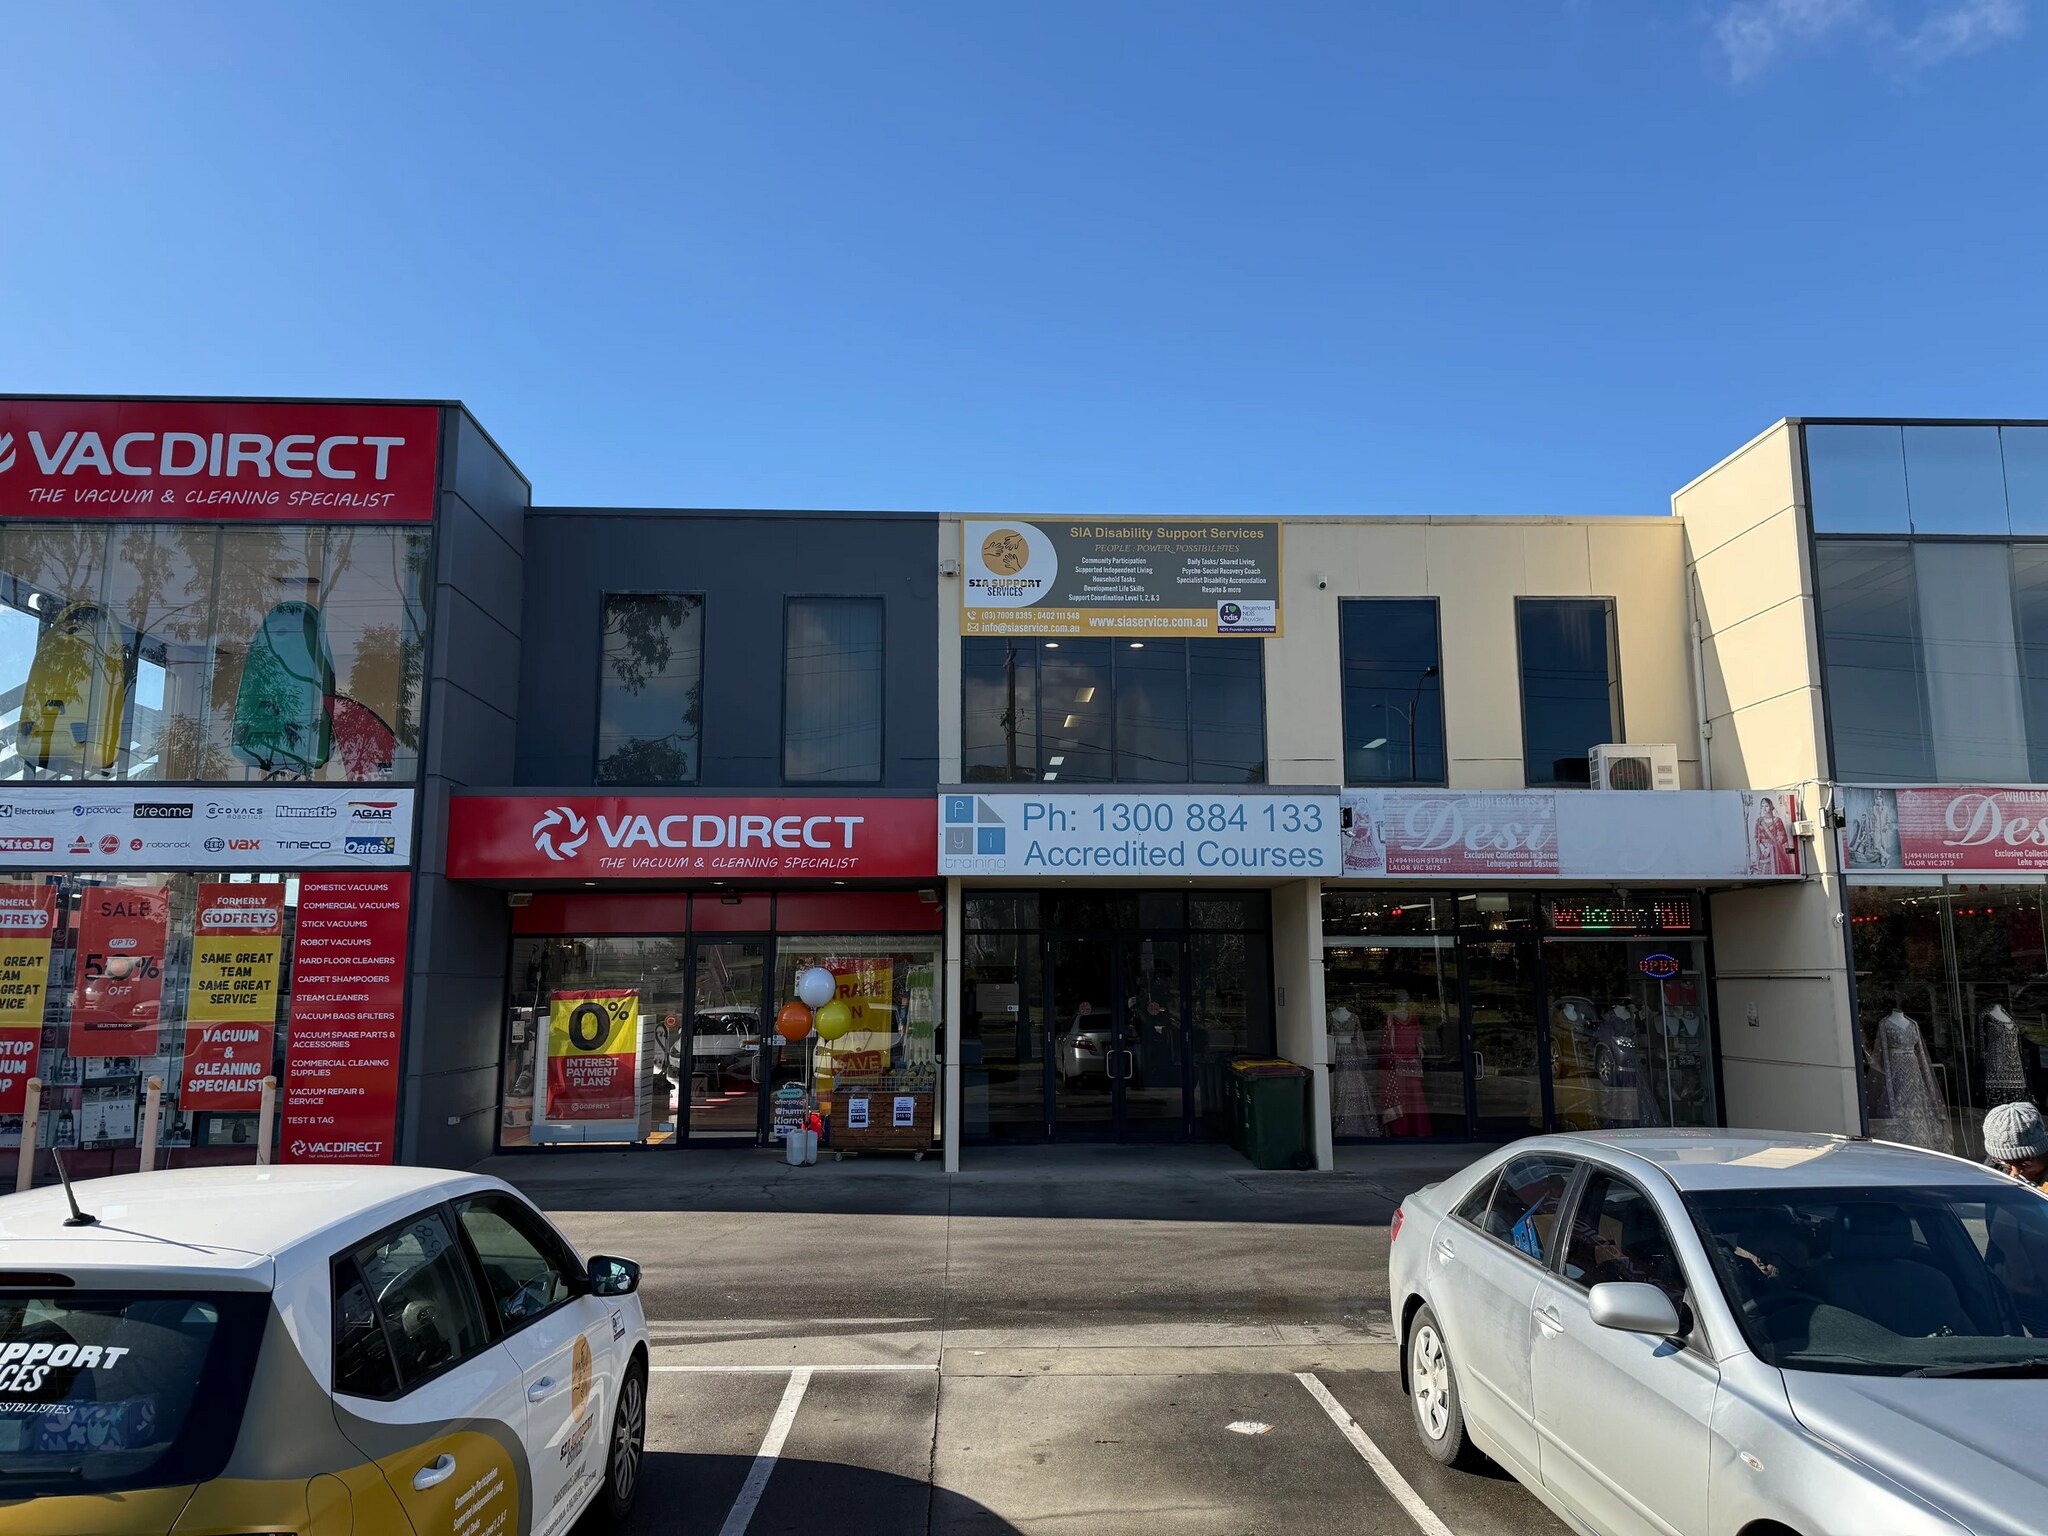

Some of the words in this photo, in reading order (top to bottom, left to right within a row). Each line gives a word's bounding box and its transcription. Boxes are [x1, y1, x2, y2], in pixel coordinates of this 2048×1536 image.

[28, 431, 405, 480] VACDIRECT
[29, 488, 67, 503] THE
[74, 489, 153, 503] VACUUM
[161, 490, 175, 503] &
[185, 490, 280, 506] CLEANING
[287, 491, 395, 508] SPECIALIST
[1070, 527, 1092, 538] SIA
[1095, 527, 1153, 541] Disability
[1157, 527, 1207, 540] Support
[1210, 528, 1264, 539] Services
[1095, 544, 1131, 552] PEOPLE
[1136, 544, 1176, 554] POWER
[1081, 556, 1111, 565] Community
[1112, 557, 1146, 565] Participation
[1187, 558, 1200, 566] Daily
[1239, 558, 1255, 566] Living
[1075, 566, 1102, 574] Supported
[1103, 566, 1136, 574] Independent
[1137, 567, 1153, 575] Living
[1220, 568, 1243, 576] Recovery
[969, 579, 989, 588] SIA
[992, 579, 1042, 588] SUPPORT
[1093, 575, 1120, 583] Household
[1120, 575, 1136, 583] Tasks
[1203, 577, 1228, 585] Disability
[987, 587, 1023, 597] SERVICES
[1202, 586, 1222, 594] Respite
[981, 611, 996, 620] (03)
[997, 611, 1014, 620] 7009
[1015, 611, 1032, 620] 8385
[1037, 611, 1055, 620] 0402
[1067, 612, 1080, 620] 548
[1089, 616, 1208, 628] www.siaservice.com.au
[982, 622, 1080, 633] info@siaservice.com.au
[2003, 791, 2048, 802] WHOLESA
[14, 807, 55, 815] Electrolux
[86, 807, 121, 816] pacvac
[135, 805, 191, 818] dreame
[275, 805, 337, 818] Numatic
[352, 809, 392, 819] AGAR
[1023, 803, 1076, 832] Ph:
[1092, 803, 1173, 832] 1300
[1186, 803, 1247, 832] 884
[1262, 803, 1323, 832] 133
[1400, 799, 1553, 850] Desi
[596, 815, 864, 848] VACDIRECT
[0, 839, 52, 850] Miele
[146, 841, 191, 849] roborock
[345, 841, 386, 853] Oates
[1023, 841, 1185, 867] Accredited
[1196, 841, 1324, 867] Courses
[1463, 851, 1495, 859] Exclusive
[1495, 851, 1529, 859] Collection
[1994, 850, 2024, 858] Exclusive
[599, 857, 625, 869] THE
[632, 857, 689, 868] VACUUM
[695, 857, 704, 868] &
[711, 857, 778, 869] CLEANING
[784, 857, 859, 869] SPECIALIST
[945, 856, 1006, 873] training
[1519, 860, 1533, 868] and
[217, 897, 267, 906] FORMERLY
[100, 901, 151, 917] SALE
[202, 911, 278, 924] GODFREYS
[302, 920, 325, 928] STICK
[326, 920, 368, 928] VACUUMS
[111, 939, 123, 947] UP
[124, 939, 136, 947] TO
[300, 938, 329, 946] ROBOT
[330, 938, 371, 946] VACUUMS
[3, 956, 43, 966] GREAT
[200, 953, 233, 964] SAME
[236, 953, 273, 964] GREAT
[352, 957, 395, 965] CLEANERS
[1639, 959, 1679, 972] OPEN
[220, 967, 252, 977] TEAM
[297, 975, 331, 983] CARPET
[331, 975, 390, 983] SHAMPOOERS
[1, 984, 40, 995] GREAT
[198, 980, 231, 991] SAME
[233, 980, 271, 991] GREAT
[108, 986, 132, 997] OFF
[210, 993, 257, 1004] SERVICE
[569, 1002, 629, 1051] 0%
[202, 1030, 259, 1043] VACUUM
[294, 1031, 331, 1039] VACUUM
[331, 1031, 359, 1039] SPARE
[224, 1047, 234, 1058] &
[291, 1059, 346, 1067] COMMERCIAL
[348, 1059, 389, 1067] CLEANING
[566, 1057, 619, 1067] INTEREST
[194, 1062, 261, 1076] CLEANING
[290, 1069, 331, 1077] SUPPLIES
[566, 1067, 618, 1077] PAYMENT
[188, 1079, 264, 1093] SPECIALIST
[573, 1077, 611, 1087] PLANS
[287, 1116, 308, 1124] TEST
[317, 1116, 334, 1124] TAG
[774, 1116, 803, 1125] Klarna
[307, 1141, 382, 1153] VACDIRECT
